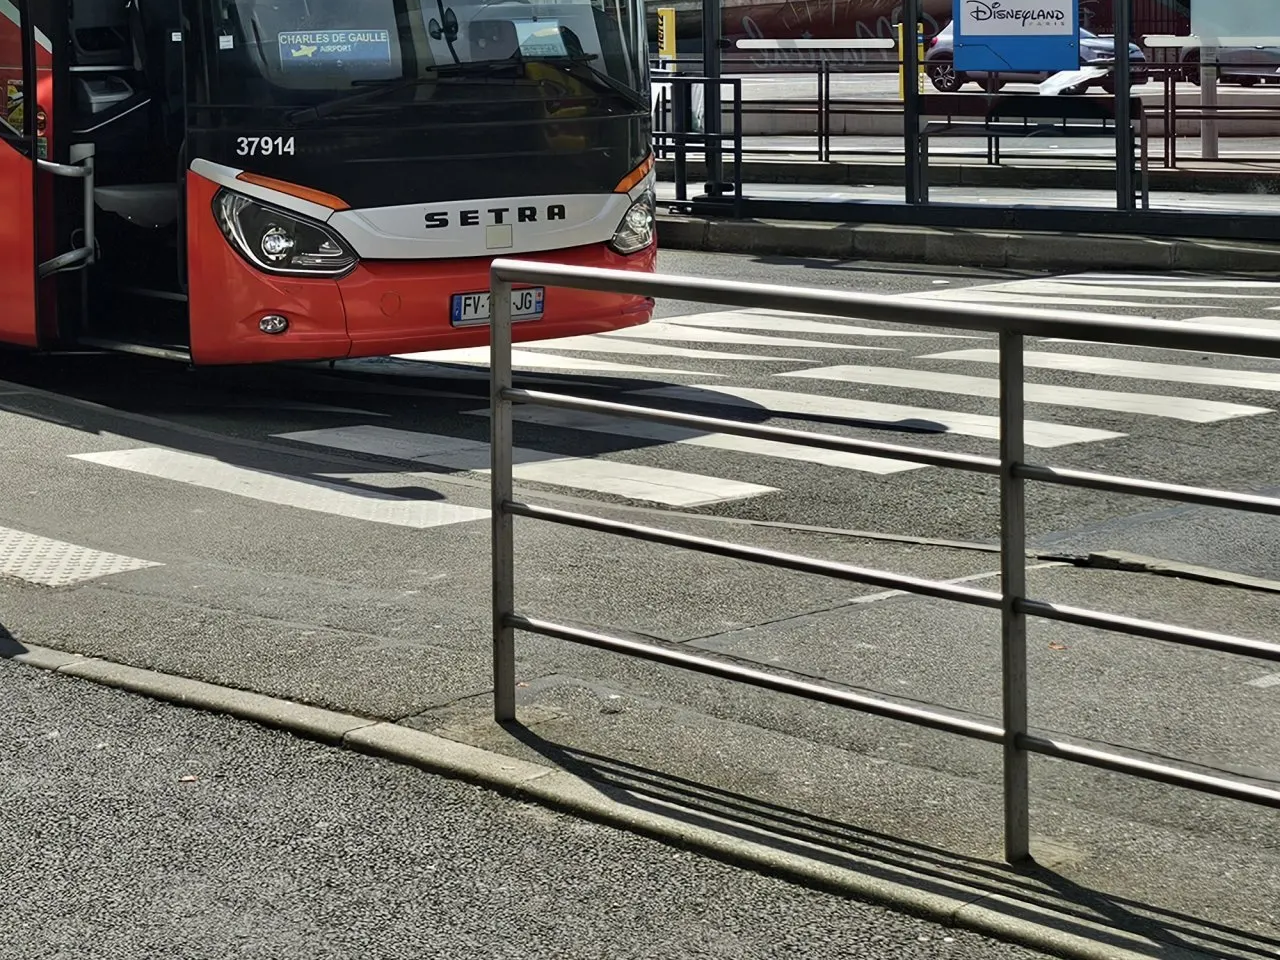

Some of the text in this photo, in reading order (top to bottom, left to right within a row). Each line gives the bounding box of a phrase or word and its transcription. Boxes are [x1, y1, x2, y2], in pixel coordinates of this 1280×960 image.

[280, 32, 388, 45] CHARLES DE GAULLE
[320, 44, 352, 53] AIRPORT
[236, 136, 295, 156] 37914
[424, 204, 566, 229] SETRA
